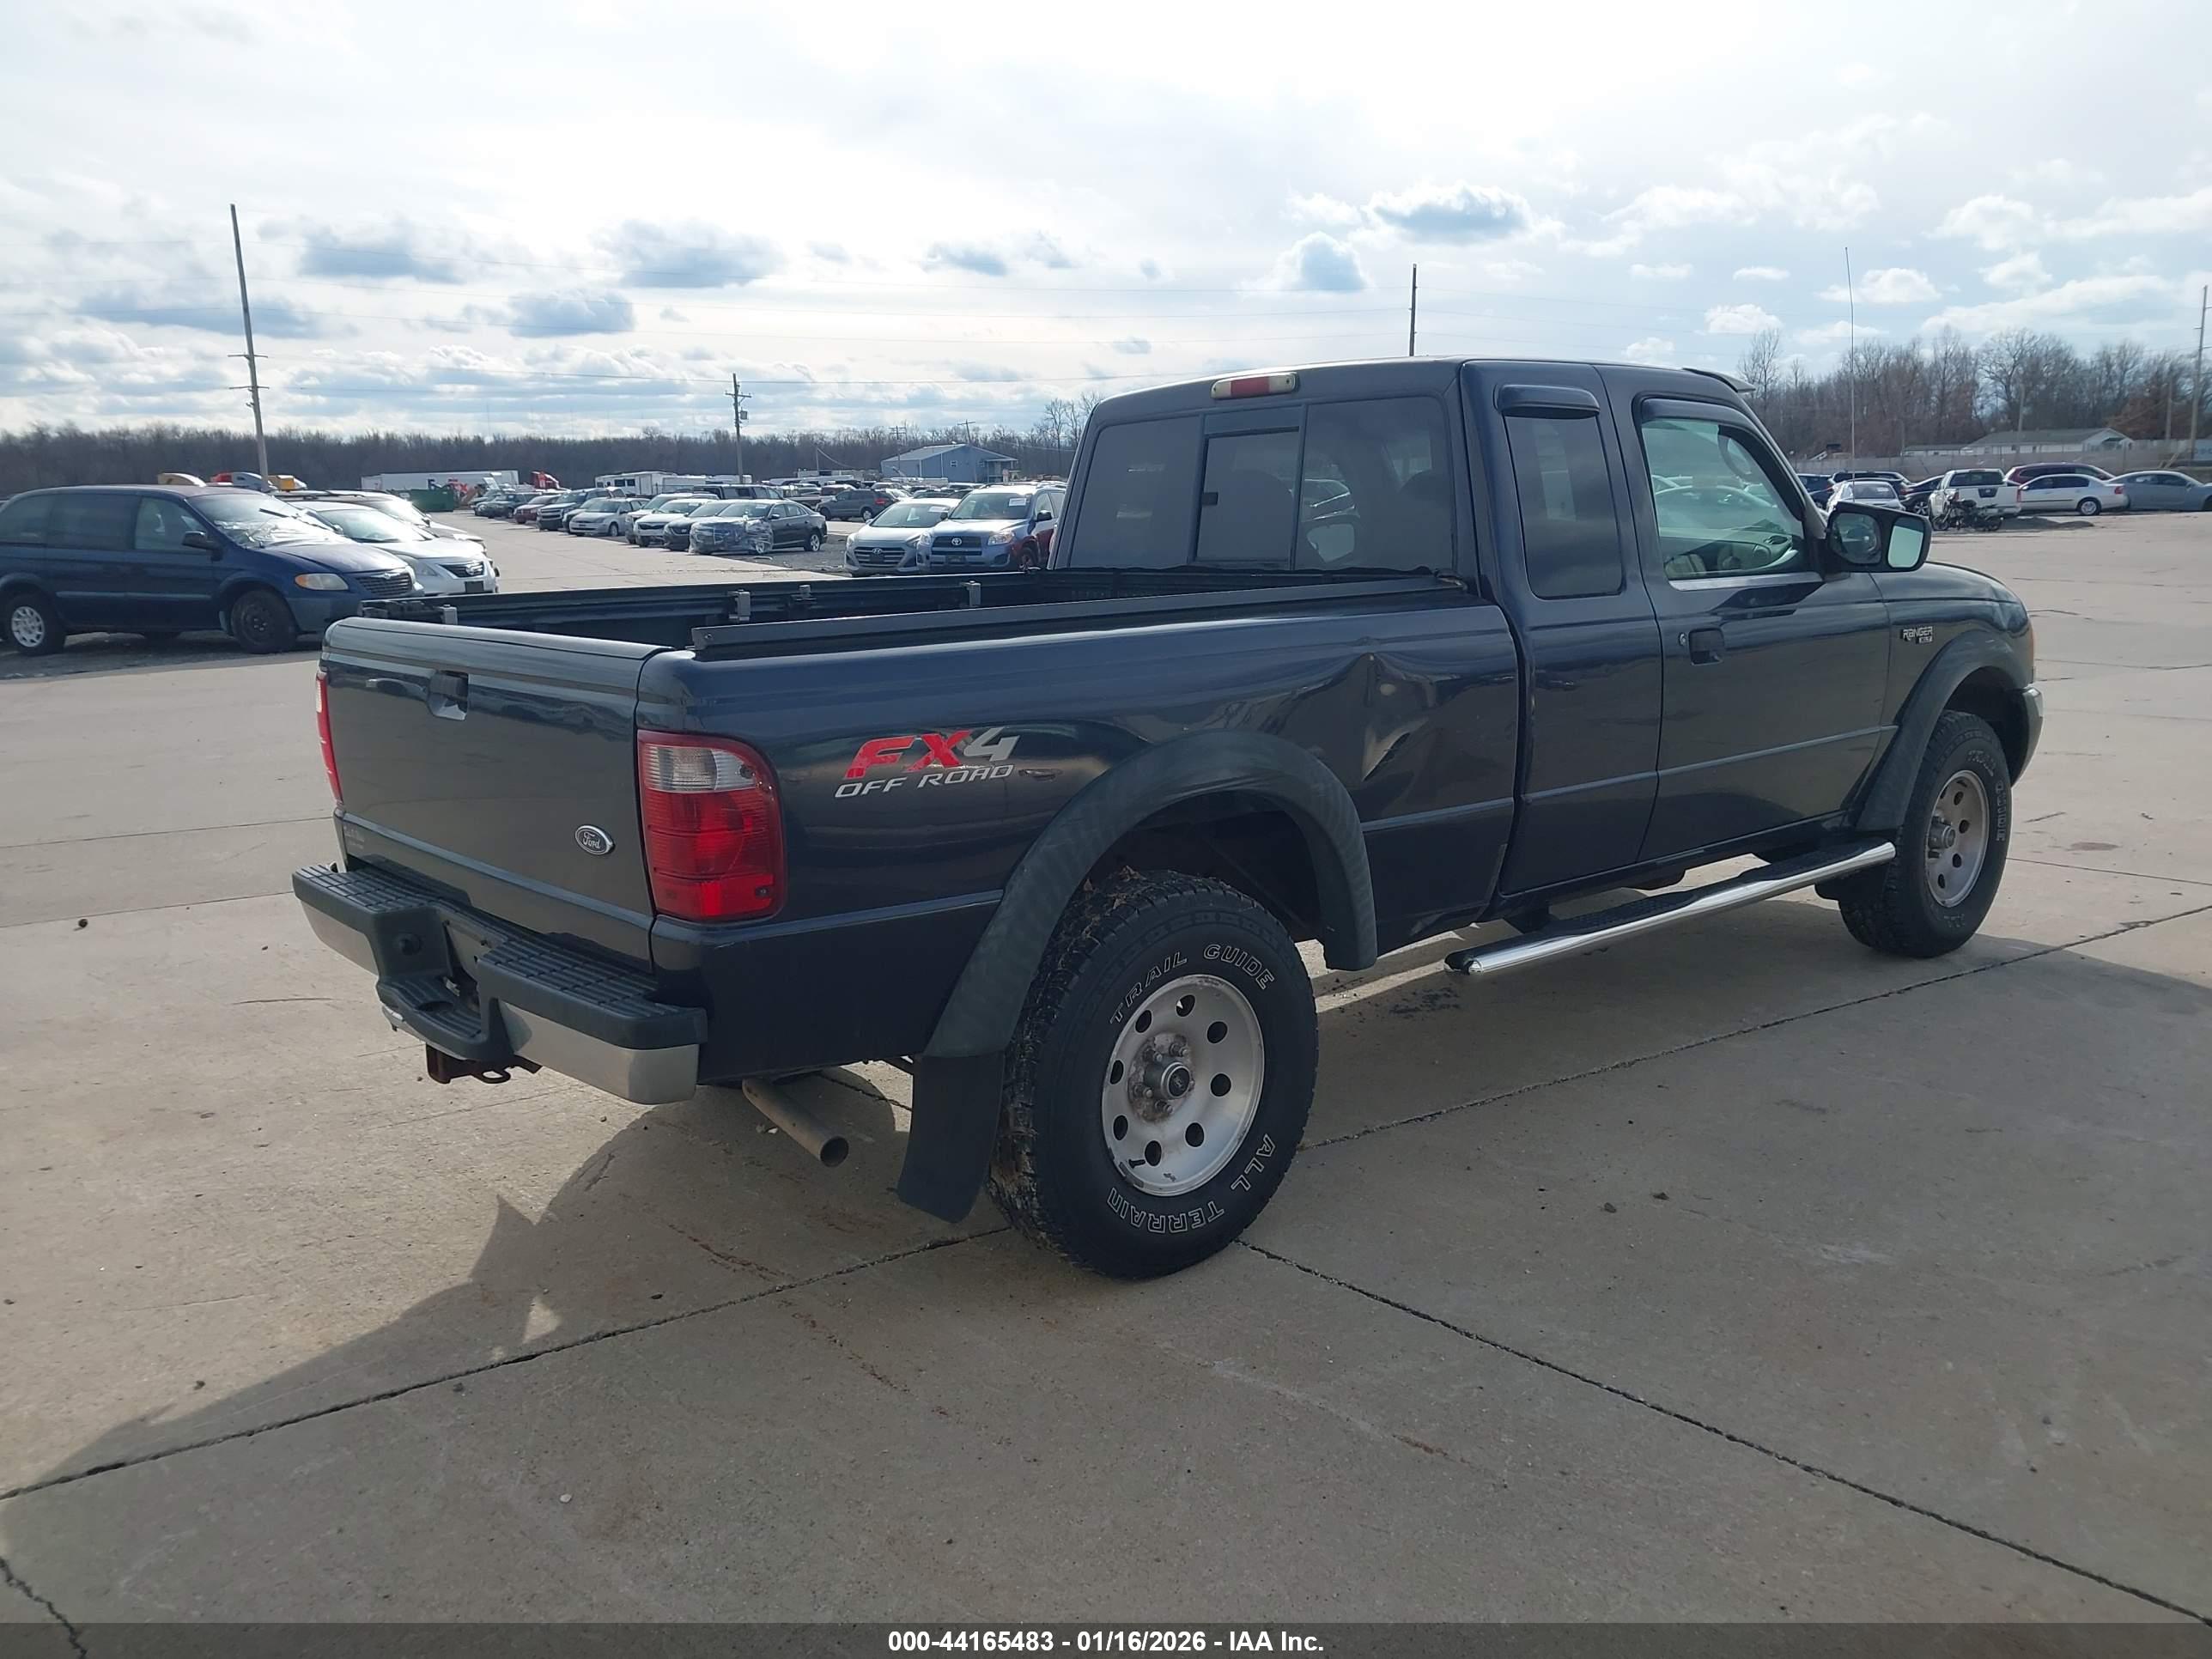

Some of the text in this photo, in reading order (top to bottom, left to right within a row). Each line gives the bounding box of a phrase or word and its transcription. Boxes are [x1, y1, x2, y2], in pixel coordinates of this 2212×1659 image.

[845, 726, 1020, 780] FX4
[835, 764, 1014, 798] OFF ROAD
[582, 831, 601, 848] Ford
[1109, 944, 1275, 1024] TRAIL GUIDE
[1107, 1133, 1275, 1234] ALL TERRAIN
